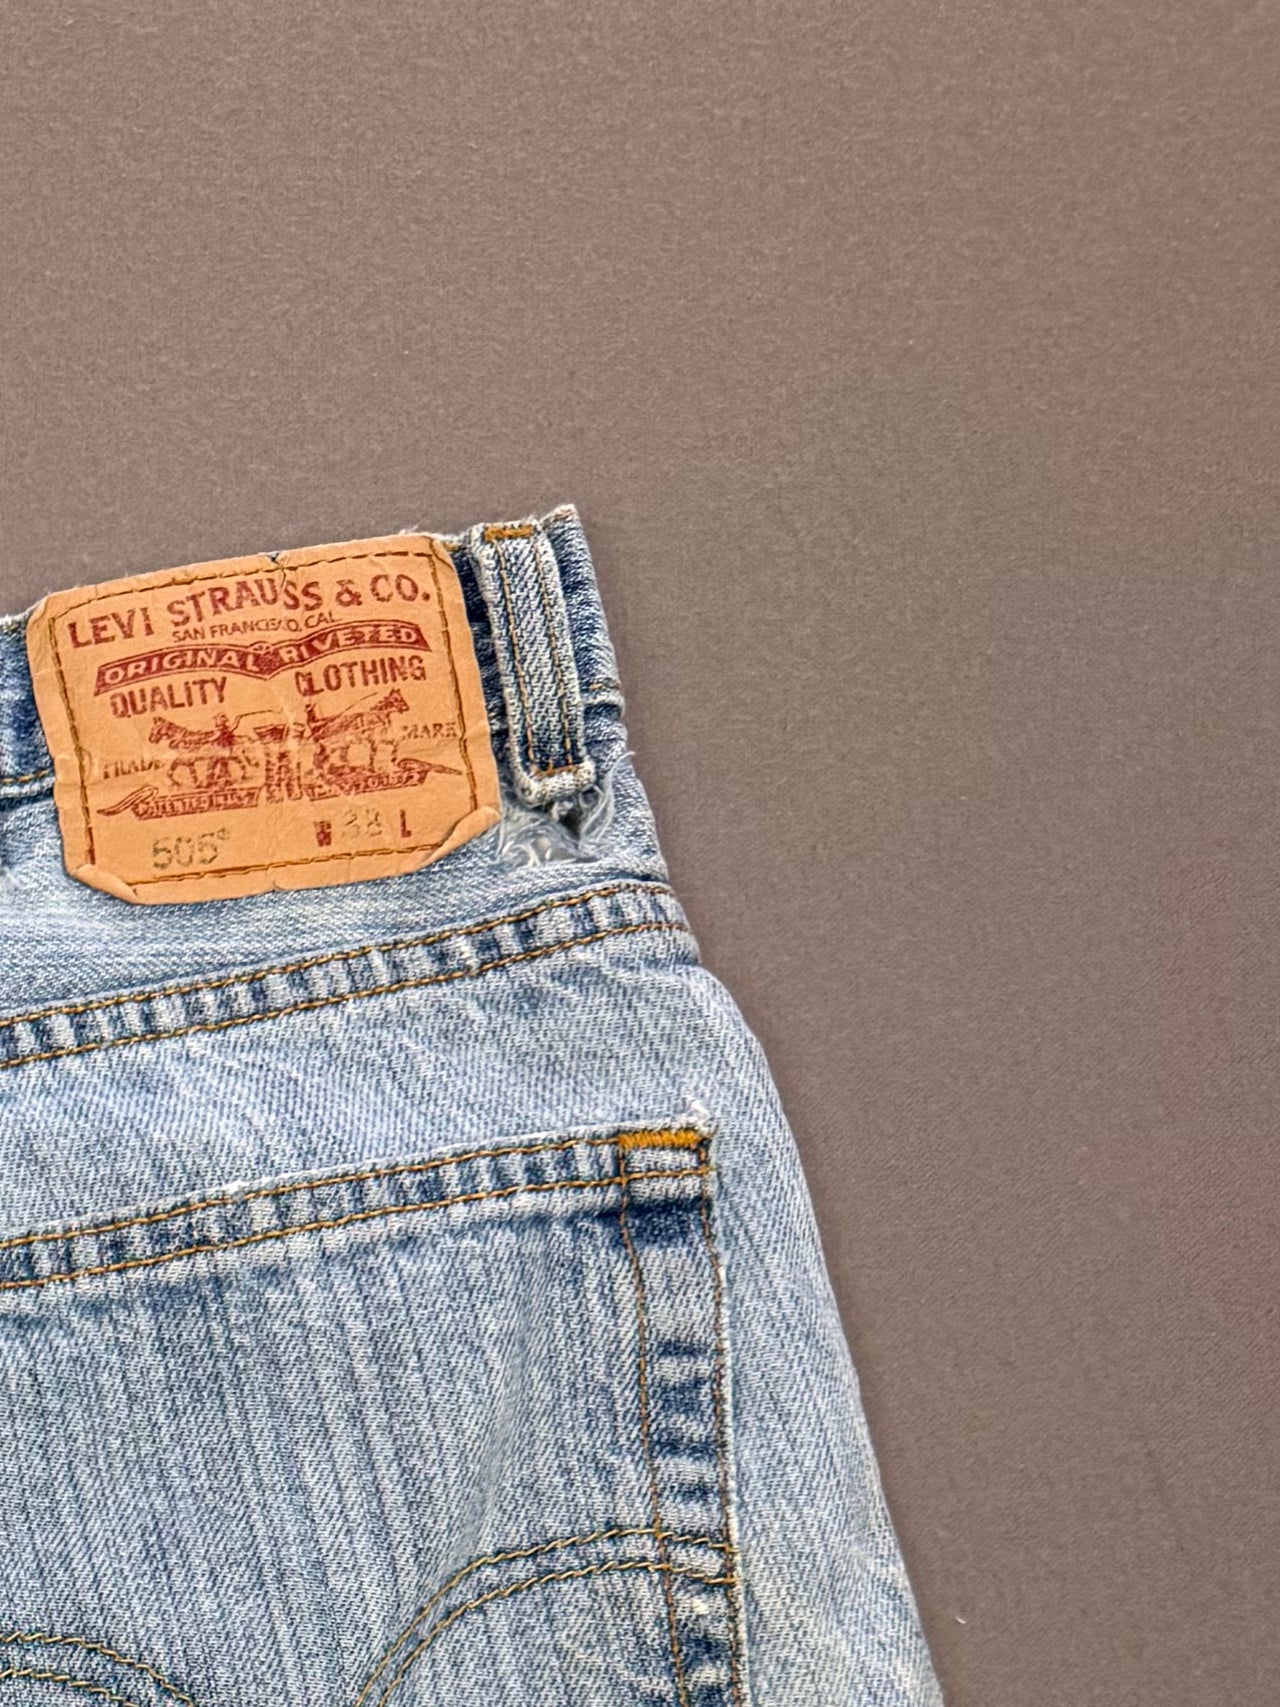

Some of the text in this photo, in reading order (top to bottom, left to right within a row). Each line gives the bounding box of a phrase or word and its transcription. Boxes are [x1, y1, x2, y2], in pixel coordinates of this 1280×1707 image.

[67, 574, 432, 649] LEVI STRAUSS & CO.
[172, 627, 206, 643] SAN
[104, 625, 418, 685] ORIGINAL RIVETED
[109, 655, 427, 718] QUALITY CLOTHING
[399, 808, 413, 839] L
